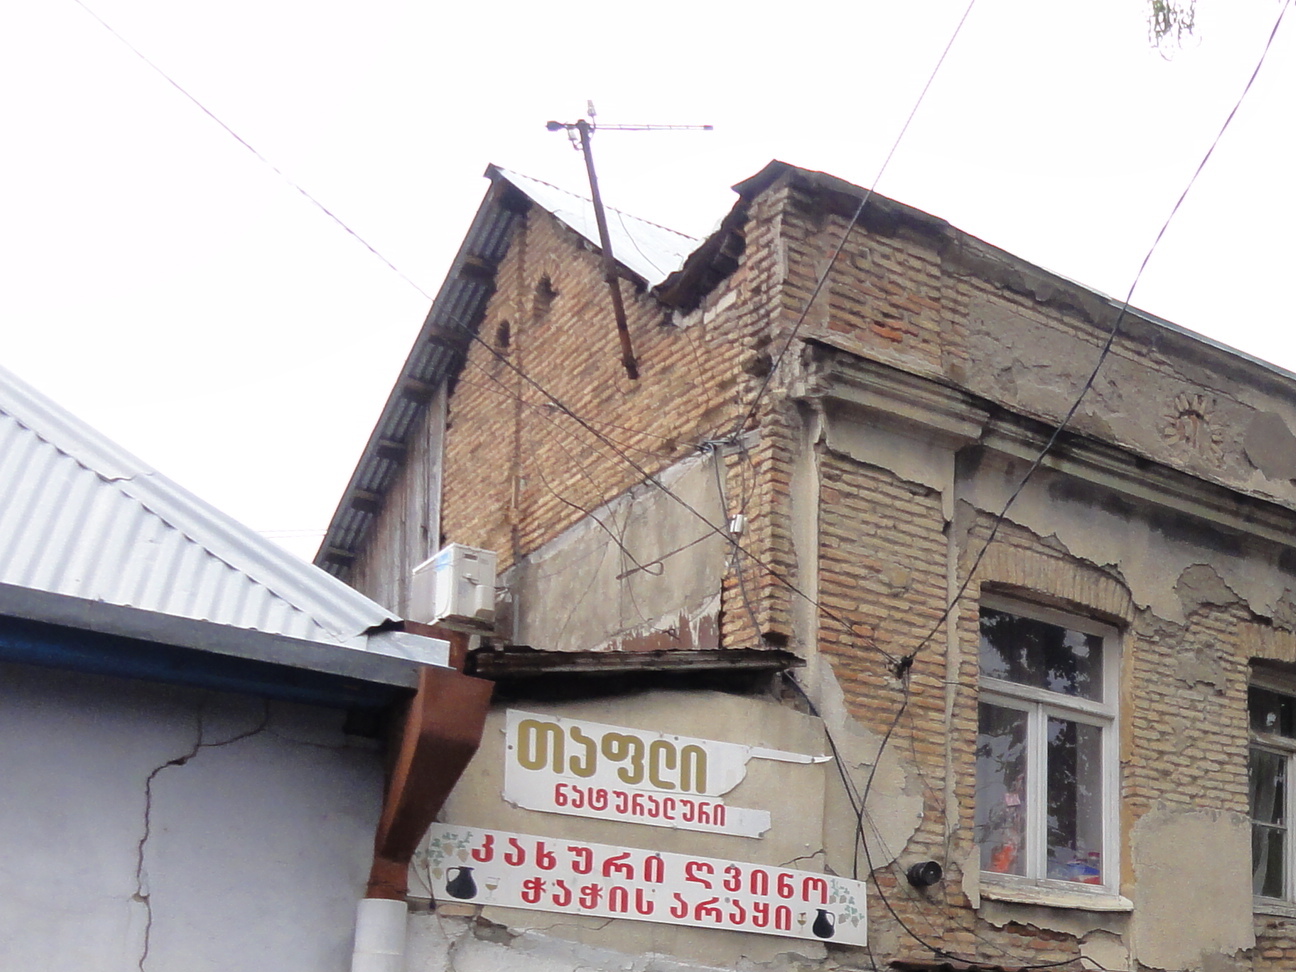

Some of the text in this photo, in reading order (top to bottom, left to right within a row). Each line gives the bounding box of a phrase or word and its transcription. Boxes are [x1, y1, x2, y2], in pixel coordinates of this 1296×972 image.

[517, 719, 707, 794] თაფლი
[554, 783, 726, 827] ნატურალური
[471, 834, 828, 905] კახური ღვინო
[520, 876, 792, 931] ჭაჭის არაყი
